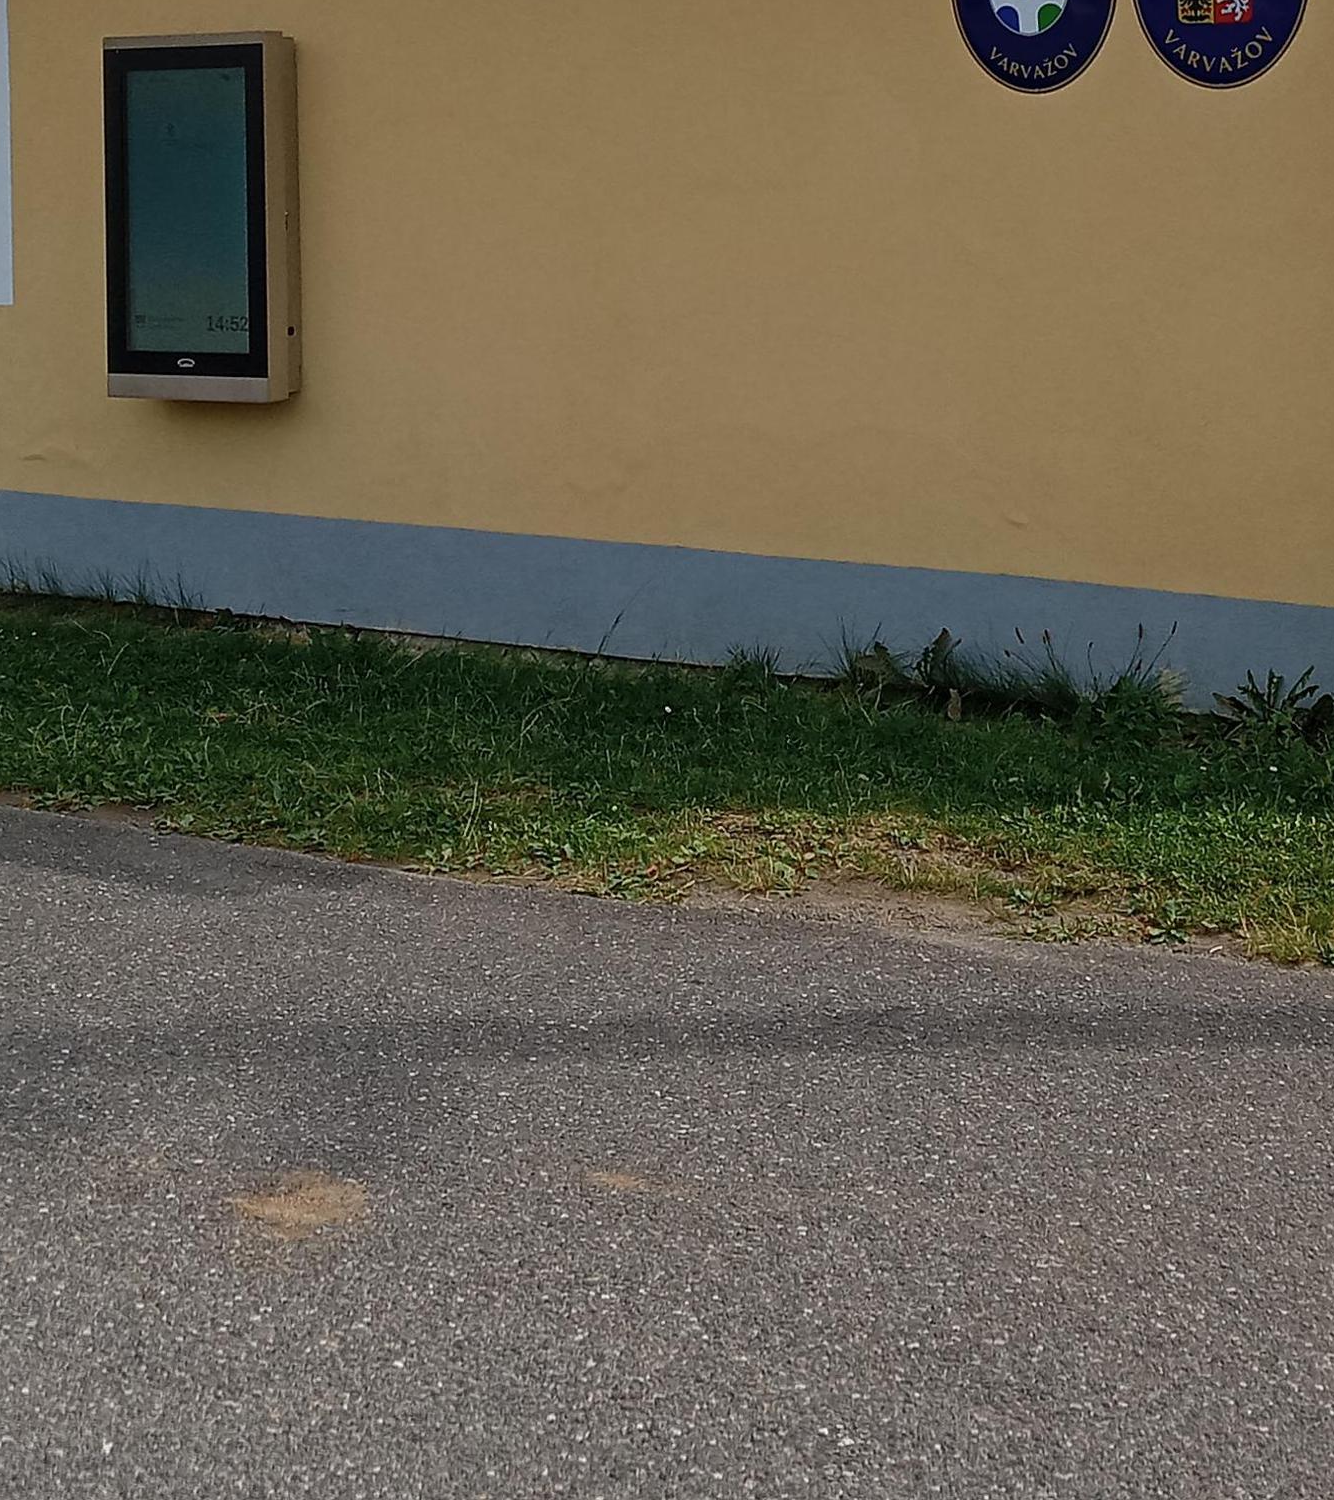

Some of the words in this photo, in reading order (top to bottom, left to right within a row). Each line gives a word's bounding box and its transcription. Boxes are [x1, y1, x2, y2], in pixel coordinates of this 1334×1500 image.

[988, 42, 1079, 80] VARVAŽOV
[1163, 26, 1274, 74] VARVAŽOV
[206, 315, 249, 333] 14:52
